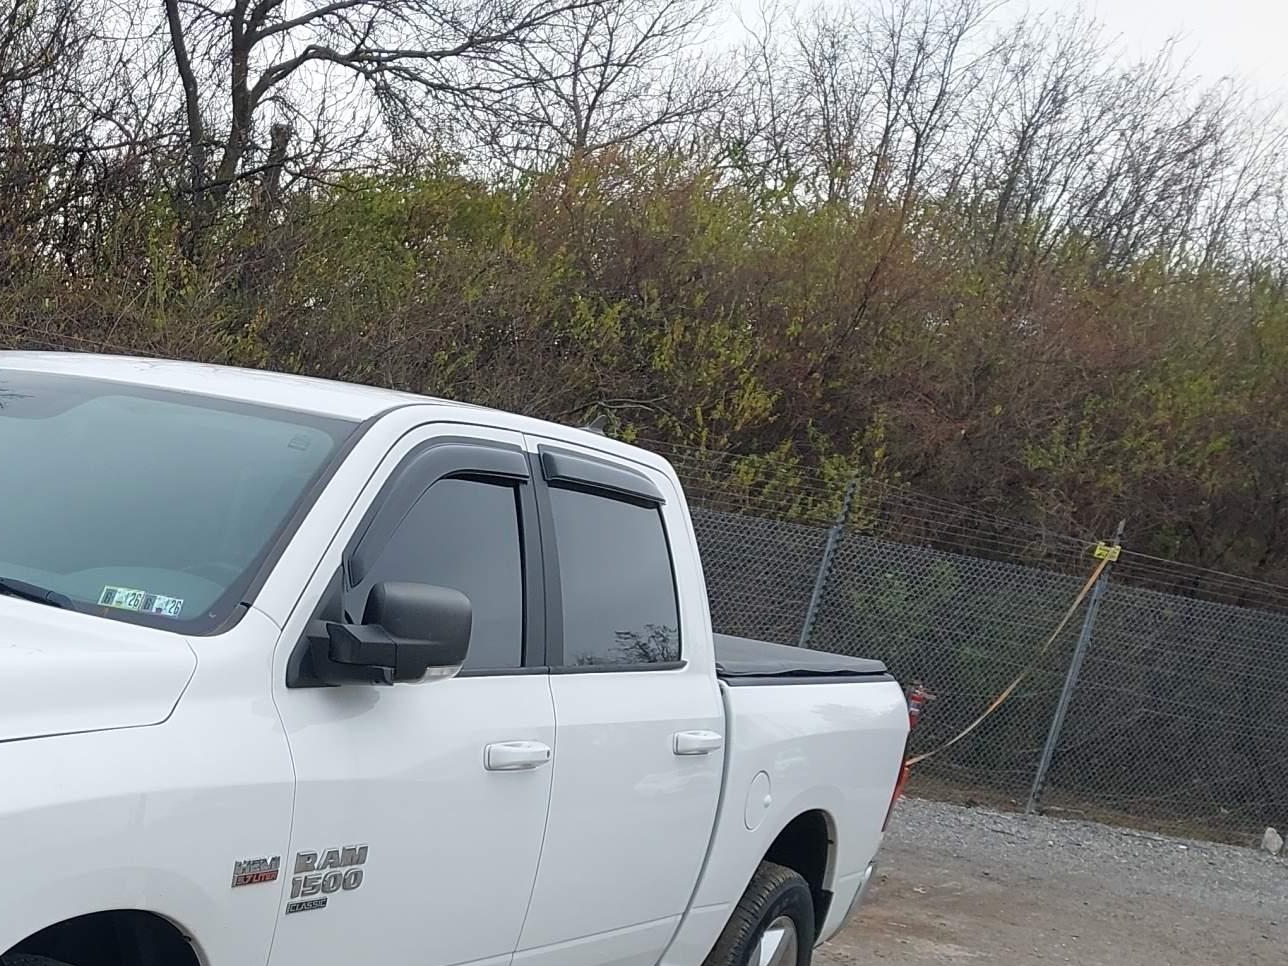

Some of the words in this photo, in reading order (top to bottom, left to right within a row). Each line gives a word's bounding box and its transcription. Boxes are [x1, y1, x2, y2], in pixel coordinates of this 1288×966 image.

[234, 856, 280, 874] HEMI
[294, 844, 368, 874] RAM
[253, 871, 277, 883] LITER
[290, 868, 364, 899] 1500
[288, 899, 327, 913] CLASSIC
